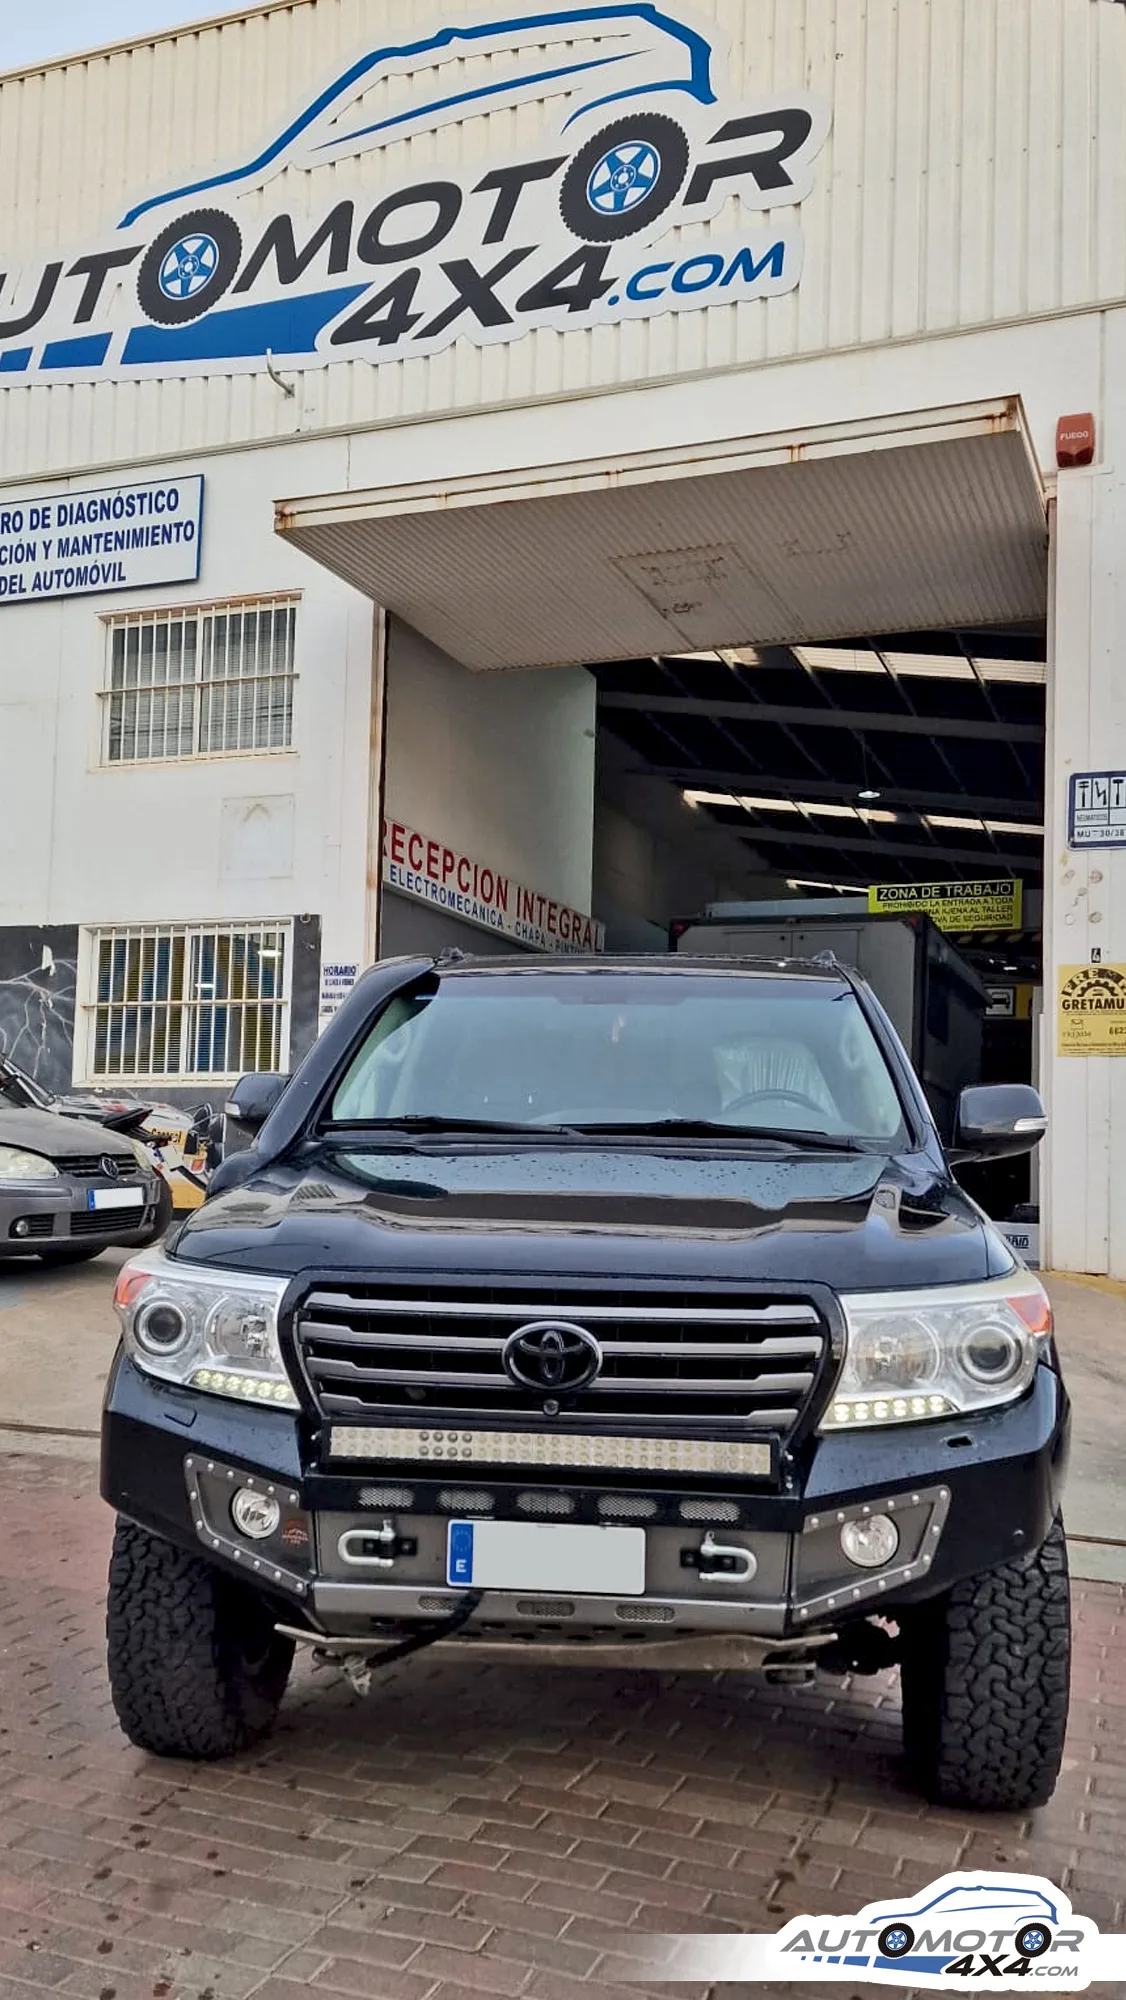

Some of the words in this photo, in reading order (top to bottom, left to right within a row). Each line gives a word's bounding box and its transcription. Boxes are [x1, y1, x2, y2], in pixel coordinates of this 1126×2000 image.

[1060, 431, 1088, 440] FUEGO
[0, 510, 23, 534] RO
[29, 506, 51, 531] DE
[57, 488, 179, 527] DIAGNÓSTICO
[0, 539, 36, 566] CIÓN
[43, 540, 52, 560] Y
[57, 520, 195, 559] MANTENIMIENTO
[0, 574, 26, 596] DEL
[31, 560, 126, 592] AUTOMÓVIL
[879, 888, 917, 900] ZONA
[921, 886, 940, 898] DE
[946, 883, 1011, 897] TRABAJO
[390, 864, 504, 929] ELECTROMECANICA
[515, 921, 546, 949] CHAPA
[882, 900, 928, 909] PROHIBIDO
[942, 898, 981, 906] ENTRADA
[516, 887, 603, 952] INTEGRAL
[949, 915, 961, 923] DE
[963, 913, 1013, 922] SEGURIDAD
[1062, 998, 1125, 1010] GRETAMU
[455, 1558, 467, 1573] E
